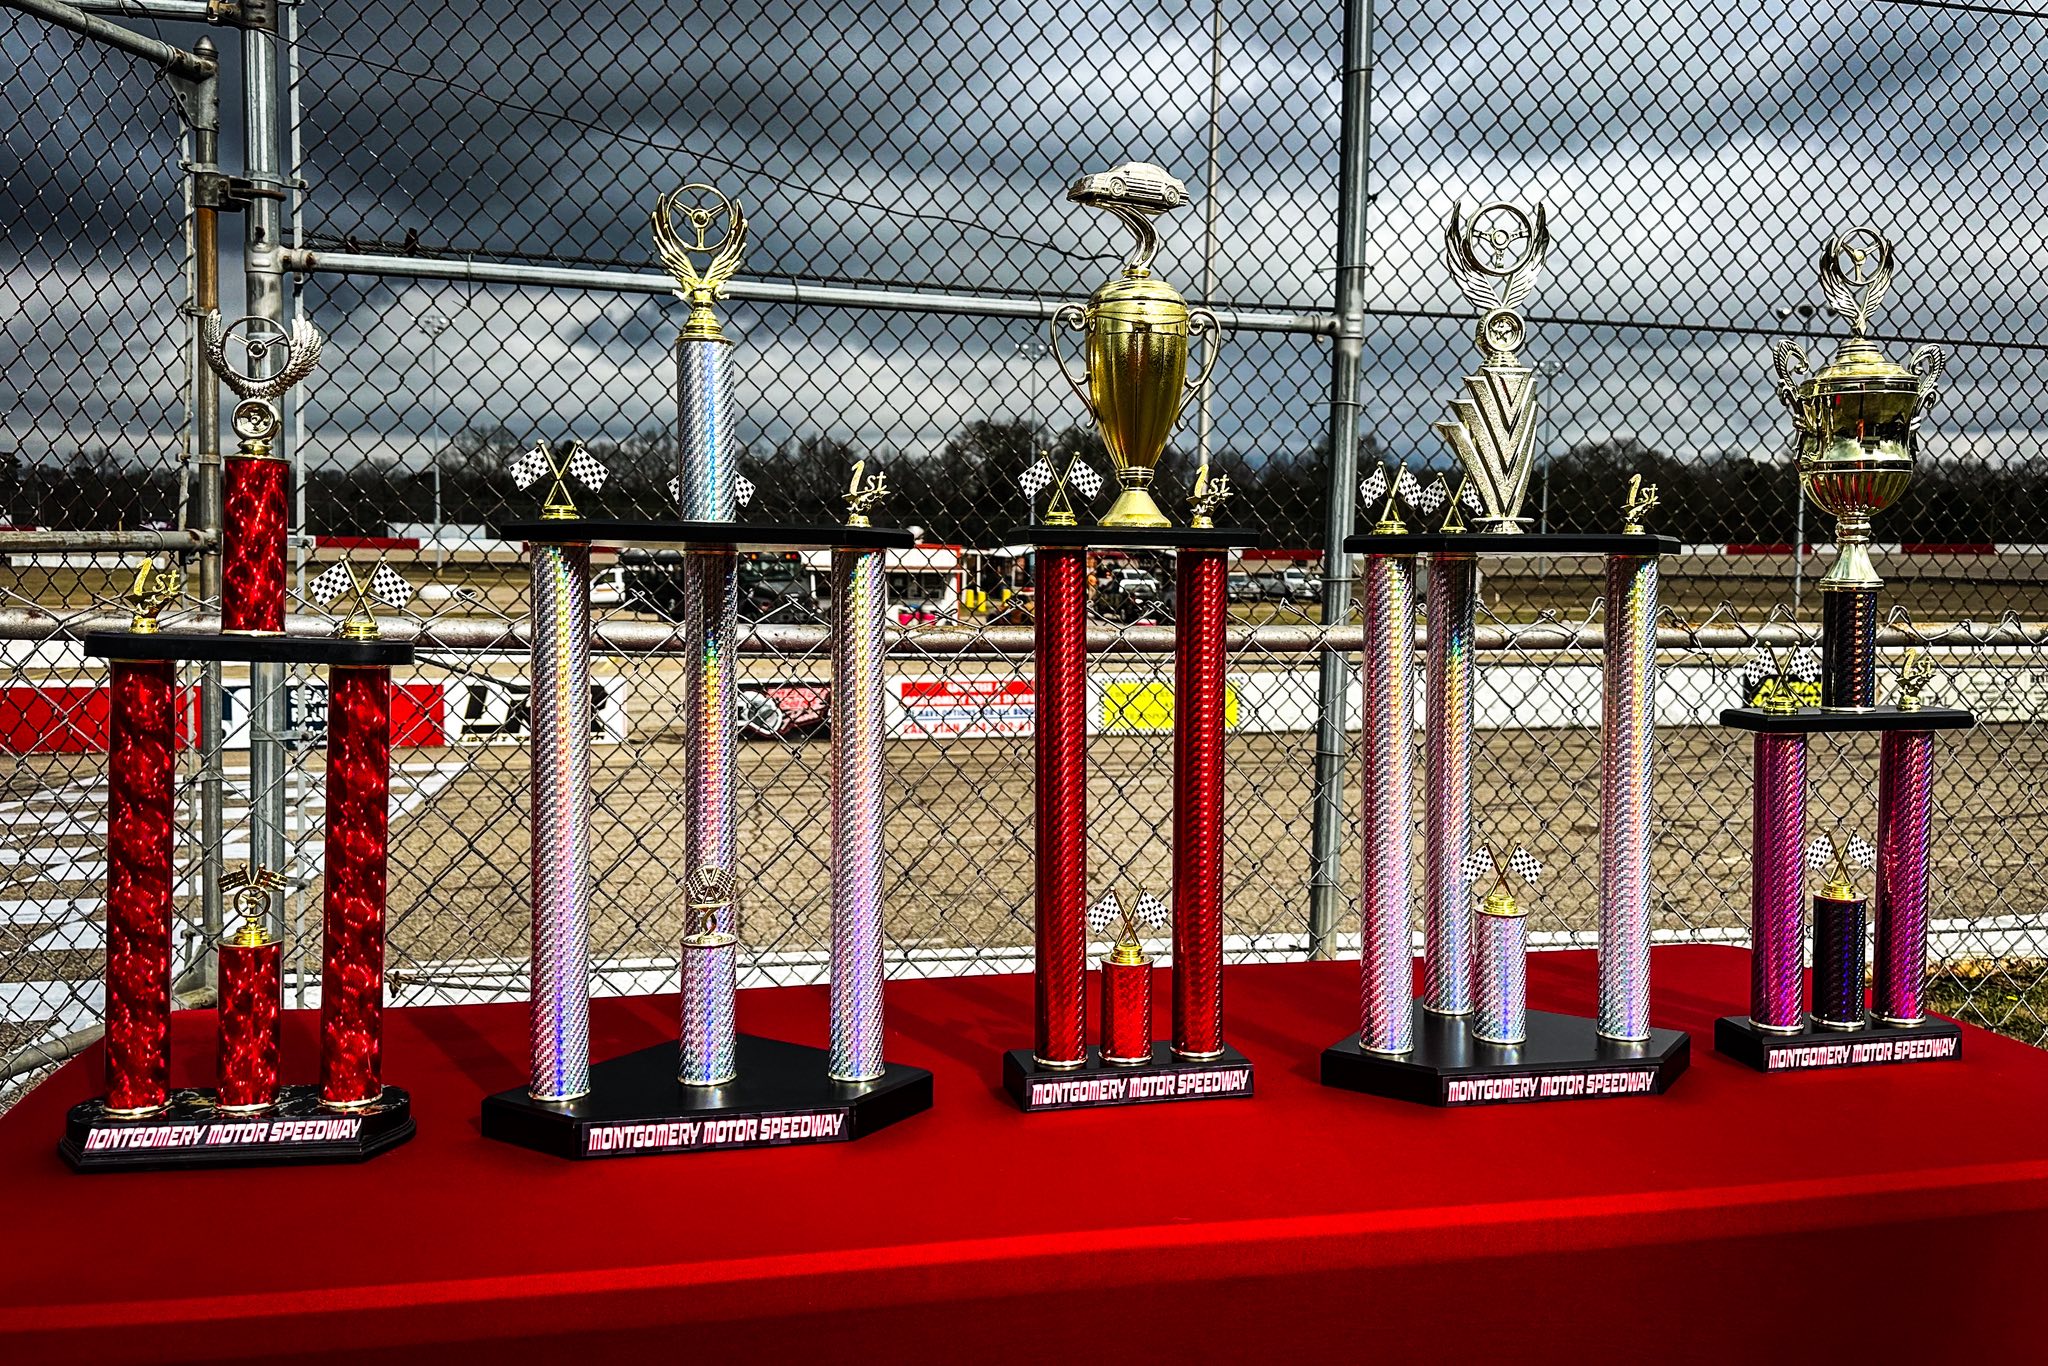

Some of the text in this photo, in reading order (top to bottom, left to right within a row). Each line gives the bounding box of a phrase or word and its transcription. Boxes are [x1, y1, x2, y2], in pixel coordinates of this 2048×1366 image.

[850, 459, 887, 495] 1st
[1194, 463, 1231, 497] 1st
[1627, 473, 1658, 506] 1st
[134, 557, 180, 596] 1st
[1768, 1037, 1957, 1069] MONTGOMERY MOTOR SPEEDWAY
[1031, 1069, 1249, 1105] MONTGOMERY MOTOR SPEEDWAY
[1448, 1071, 1655, 1102] MONTGOMERY MOTOR SPEEDWAY
[205, 1121, 269, 1145] MOTOR
[269, 1118, 362, 1143] SPEEDWAY
[588, 1113, 844, 1150] MONTGOMERY MOTOR SPEEDWAY
